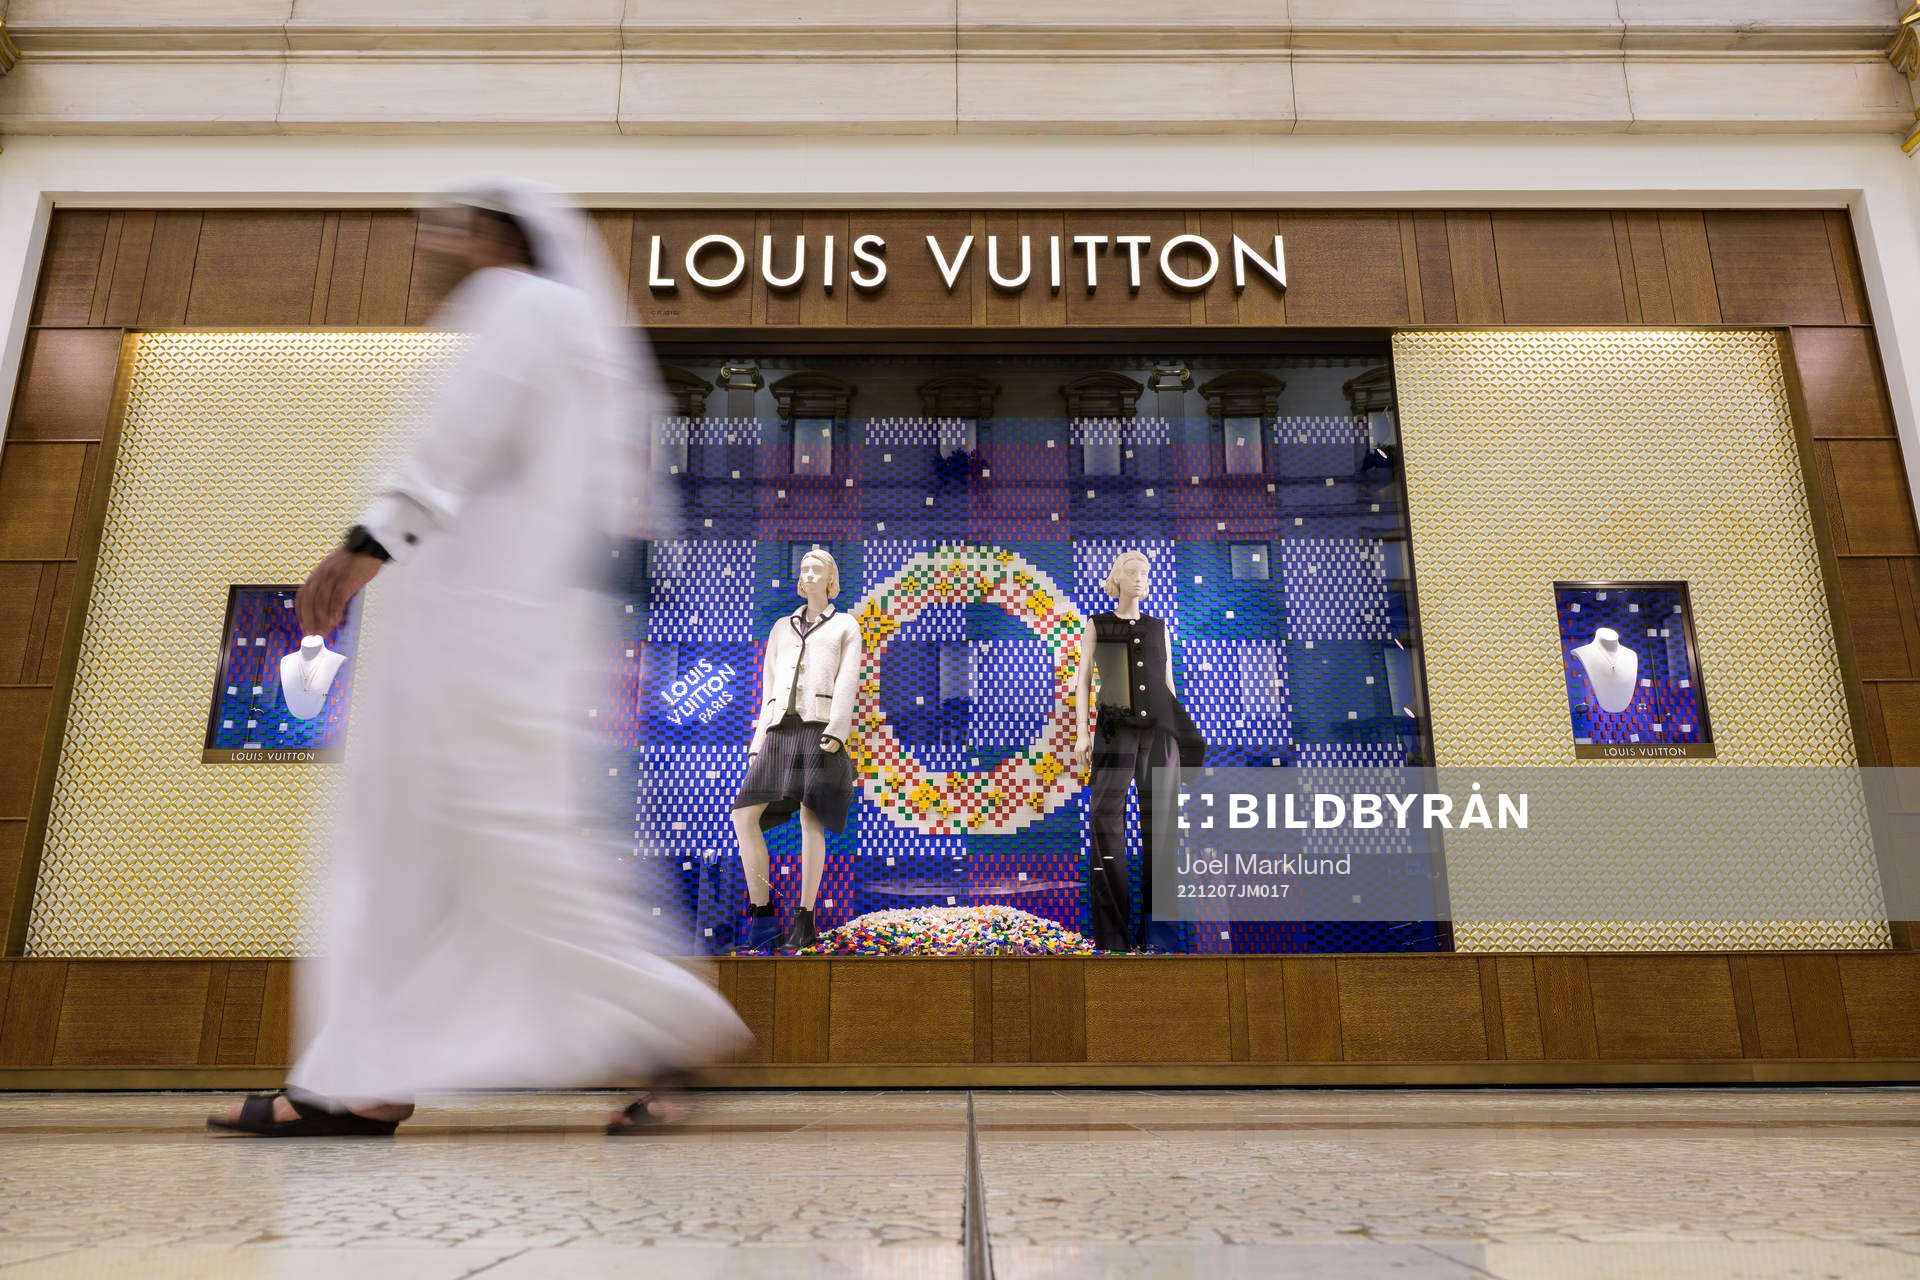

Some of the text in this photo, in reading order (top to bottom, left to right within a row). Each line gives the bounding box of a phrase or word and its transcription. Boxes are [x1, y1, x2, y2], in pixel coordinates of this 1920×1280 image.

[648, 233, 1287, 289] LOUIS VUITTON
[661, 658, 712, 705] LOUIS
[666, 663, 736, 725] VUITTON
[698, 690, 733, 723] PARIS
[231, 752, 315, 761] LOUIS VUITTON
[1603, 747, 1687, 757] LOUIS VUITTON
